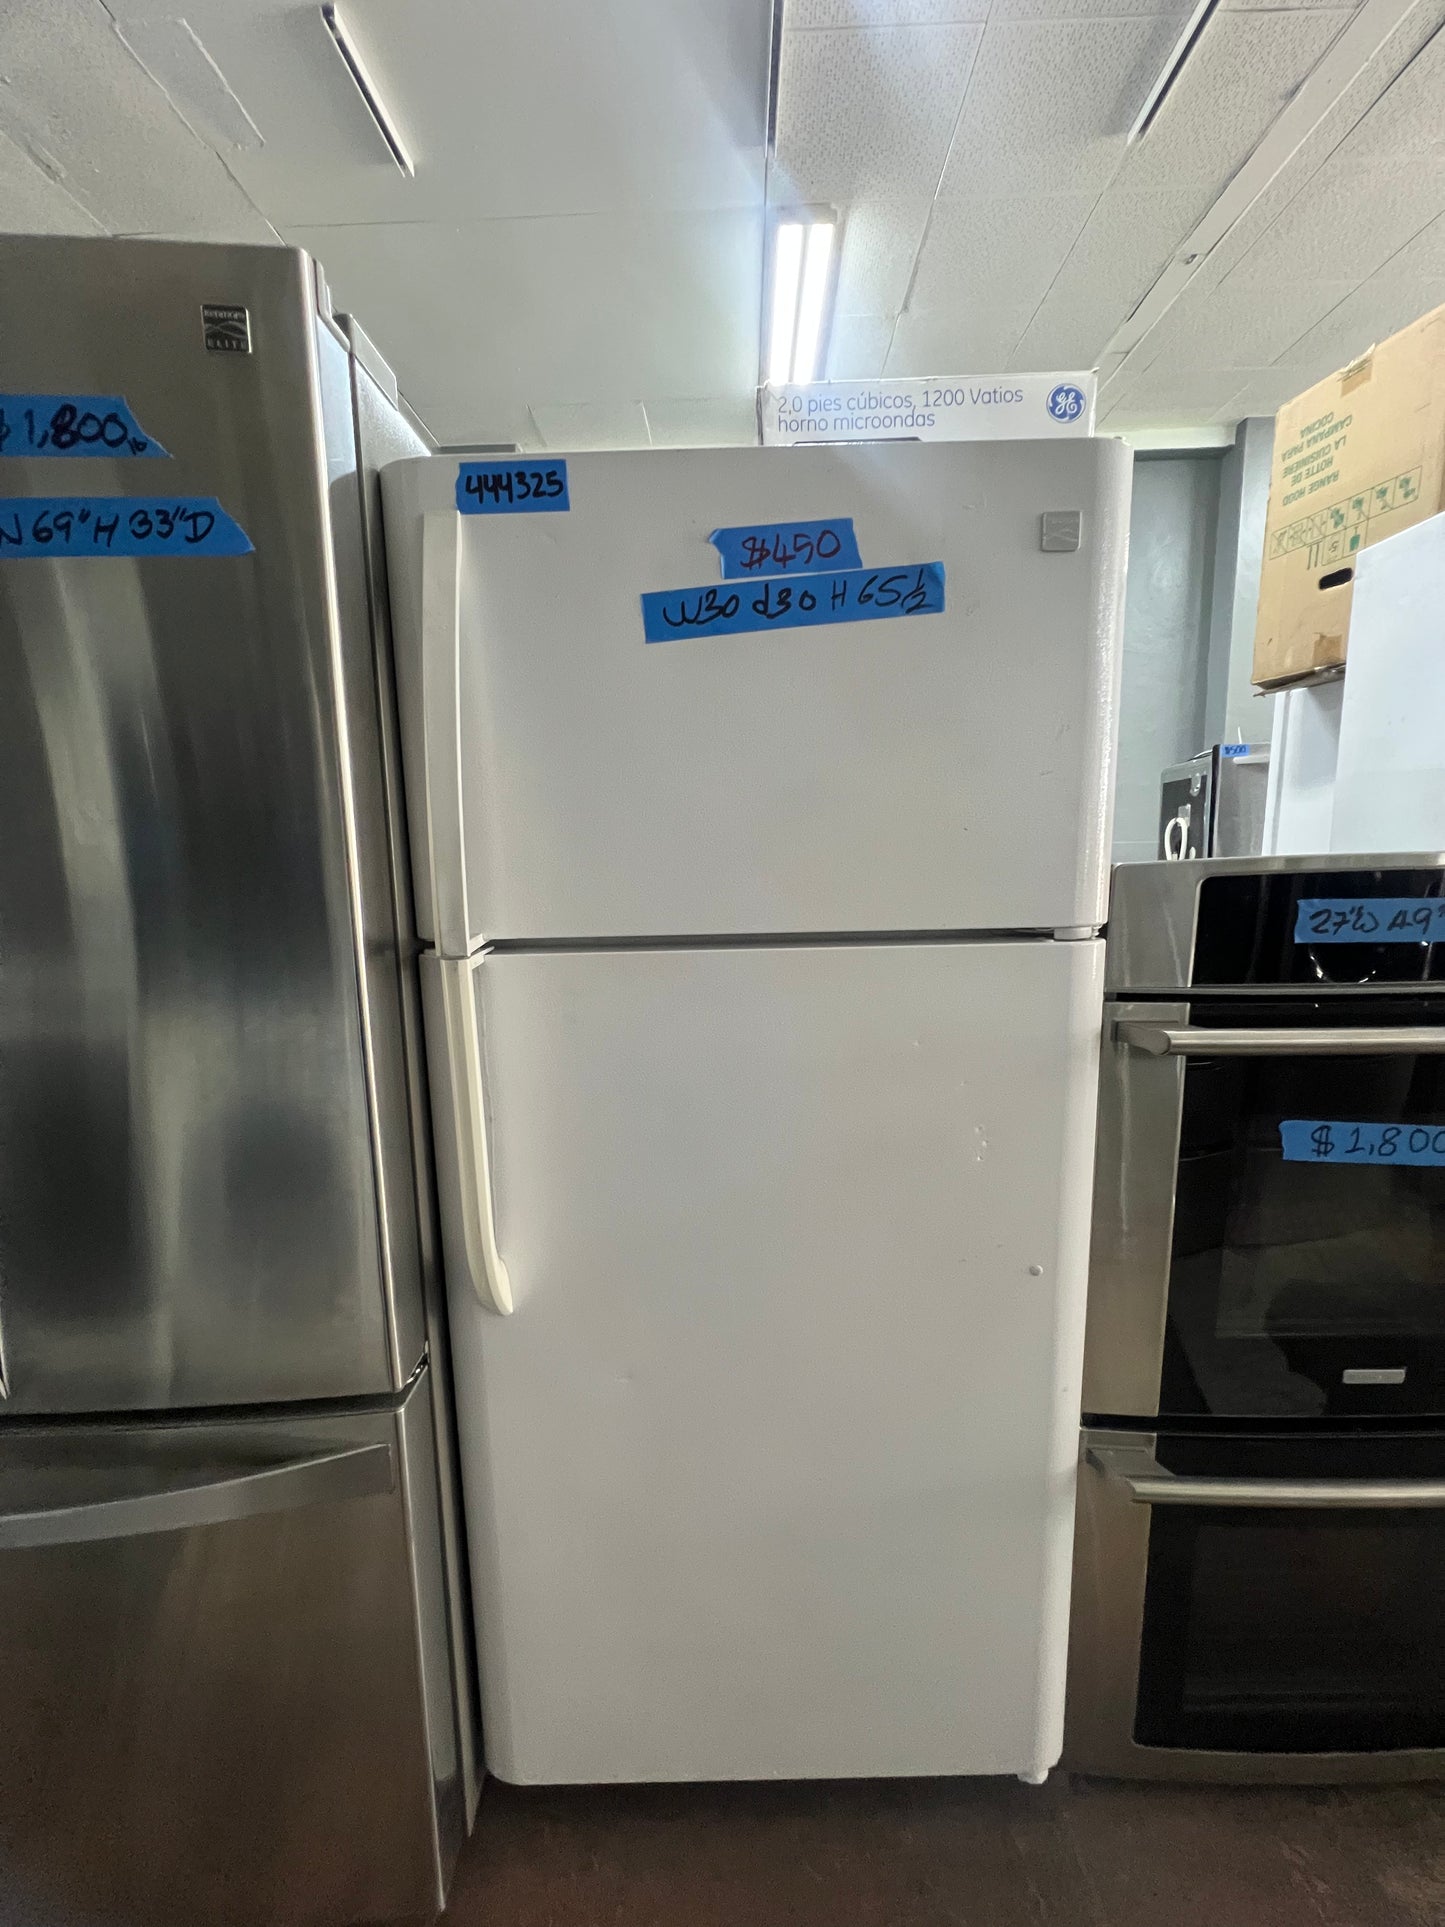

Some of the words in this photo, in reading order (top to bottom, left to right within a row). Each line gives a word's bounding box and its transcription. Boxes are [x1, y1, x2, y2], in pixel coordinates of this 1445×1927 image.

[778, 395, 802, 416] 2,0
[808, 394, 842, 417] pies
[846, 388, 917, 412] cúbicos,
[922, 389, 965, 408] 1200
[969, 386, 1023, 405] Vatios
[778, 414, 829, 433] horno
[833, 409, 935, 431] microondas
[1300, 411, 1334, 439] COCINA
[1306, 414, 1353, 448] CAMPANA
[1334, 435, 1347, 450] LA
[1291, 471, 1303, 487] DE
[1304, 456, 1334, 480] HOTTE
[465, 470, 564, 504] 444325
[1307, 470, 1340, 495] RANGE
[740, 529, 841, 570] $450
